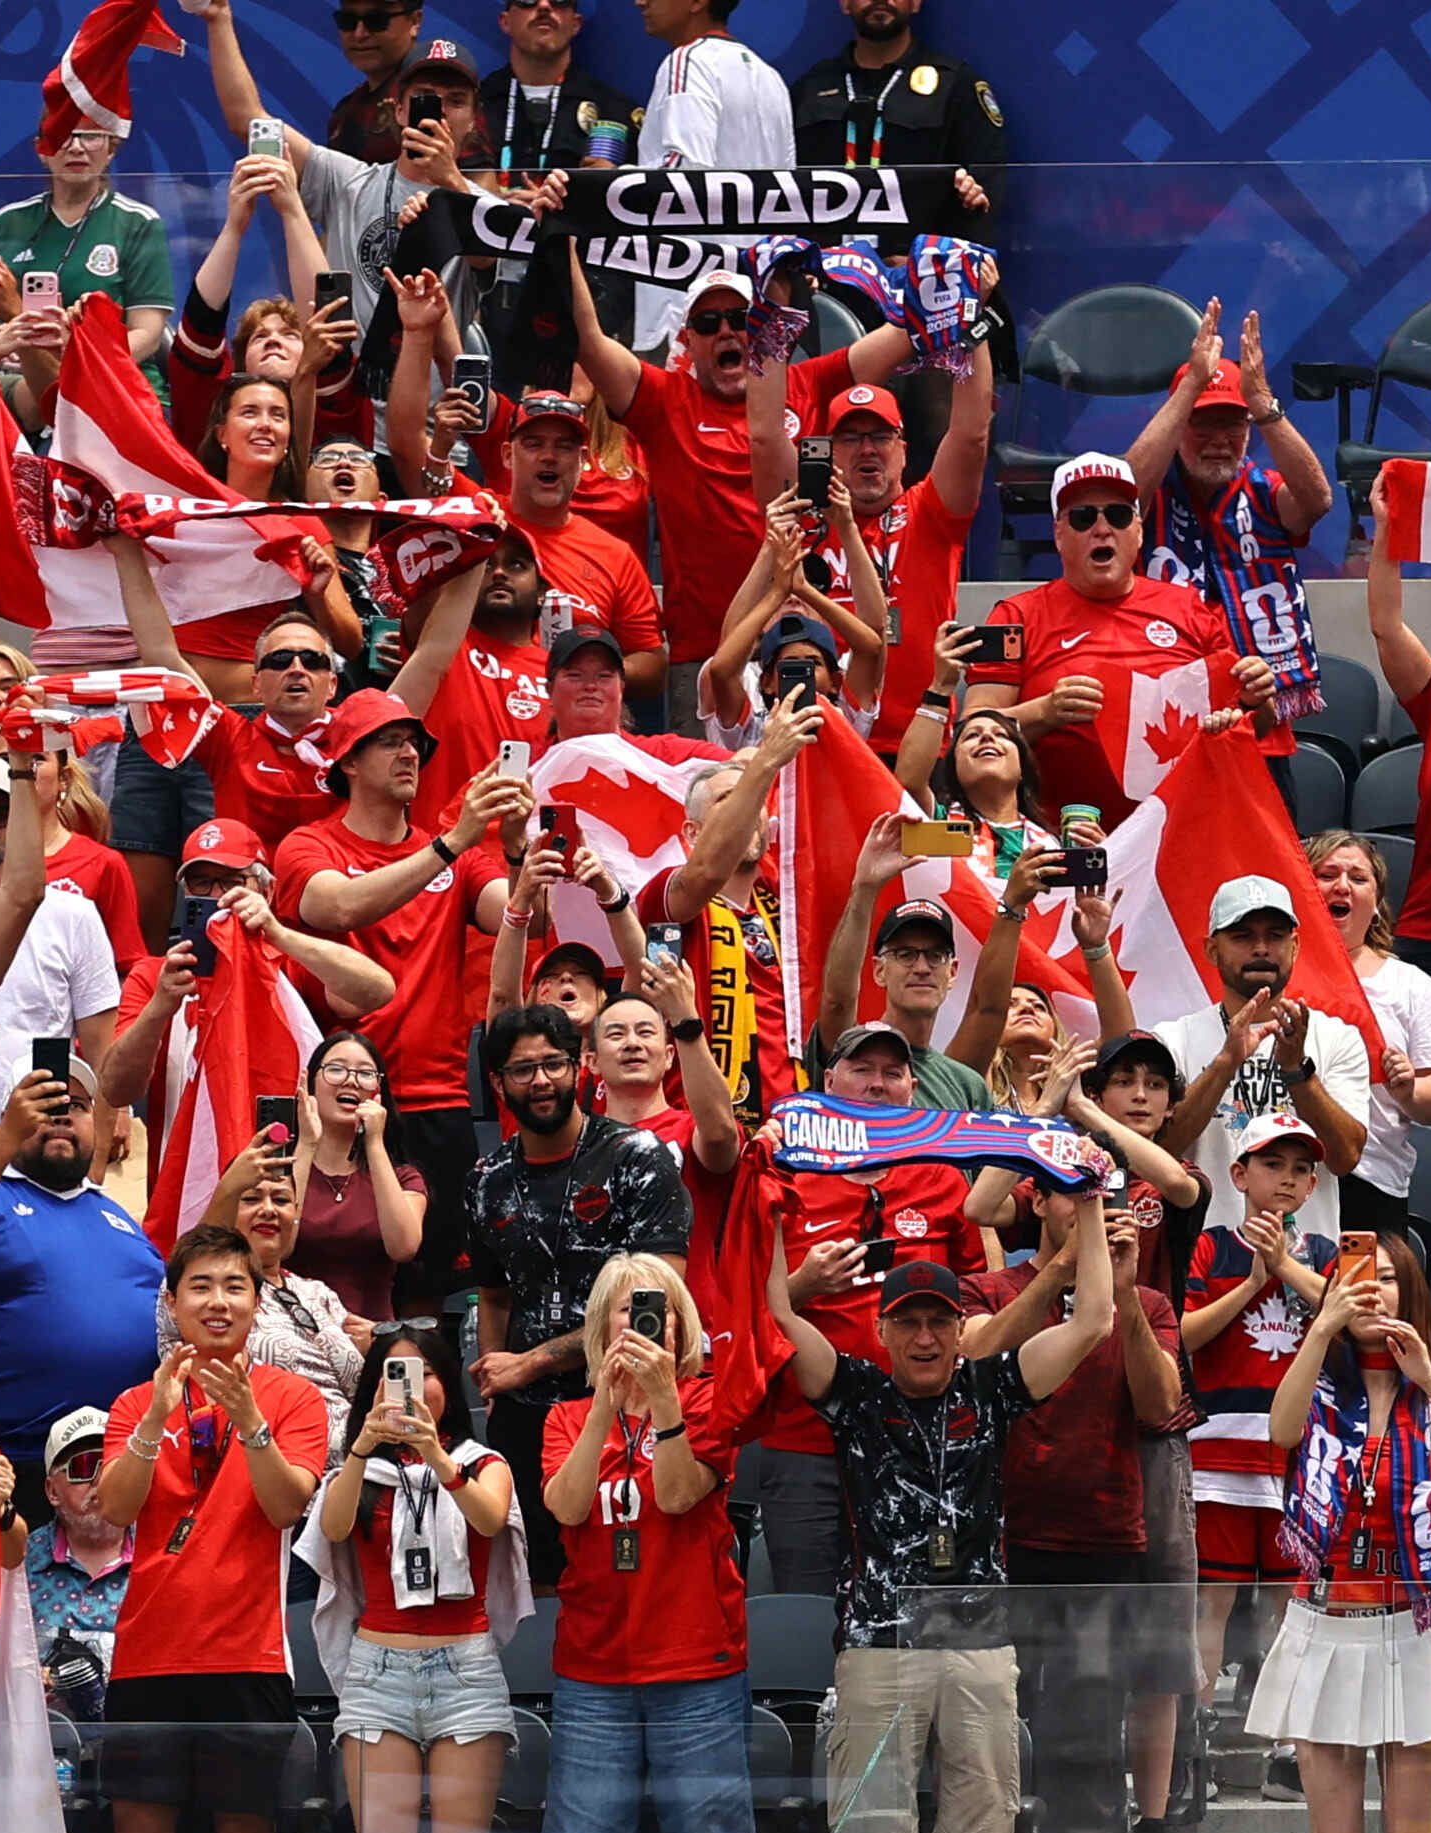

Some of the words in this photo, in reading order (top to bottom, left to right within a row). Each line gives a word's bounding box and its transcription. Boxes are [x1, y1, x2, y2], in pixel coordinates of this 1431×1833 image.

[606, 168, 909, 226] CANADA
[1064, 463, 1122, 485] CANADA
[784, 1111, 868, 1152] CANADA
[1250, 1319, 1299, 1337] CANADA
